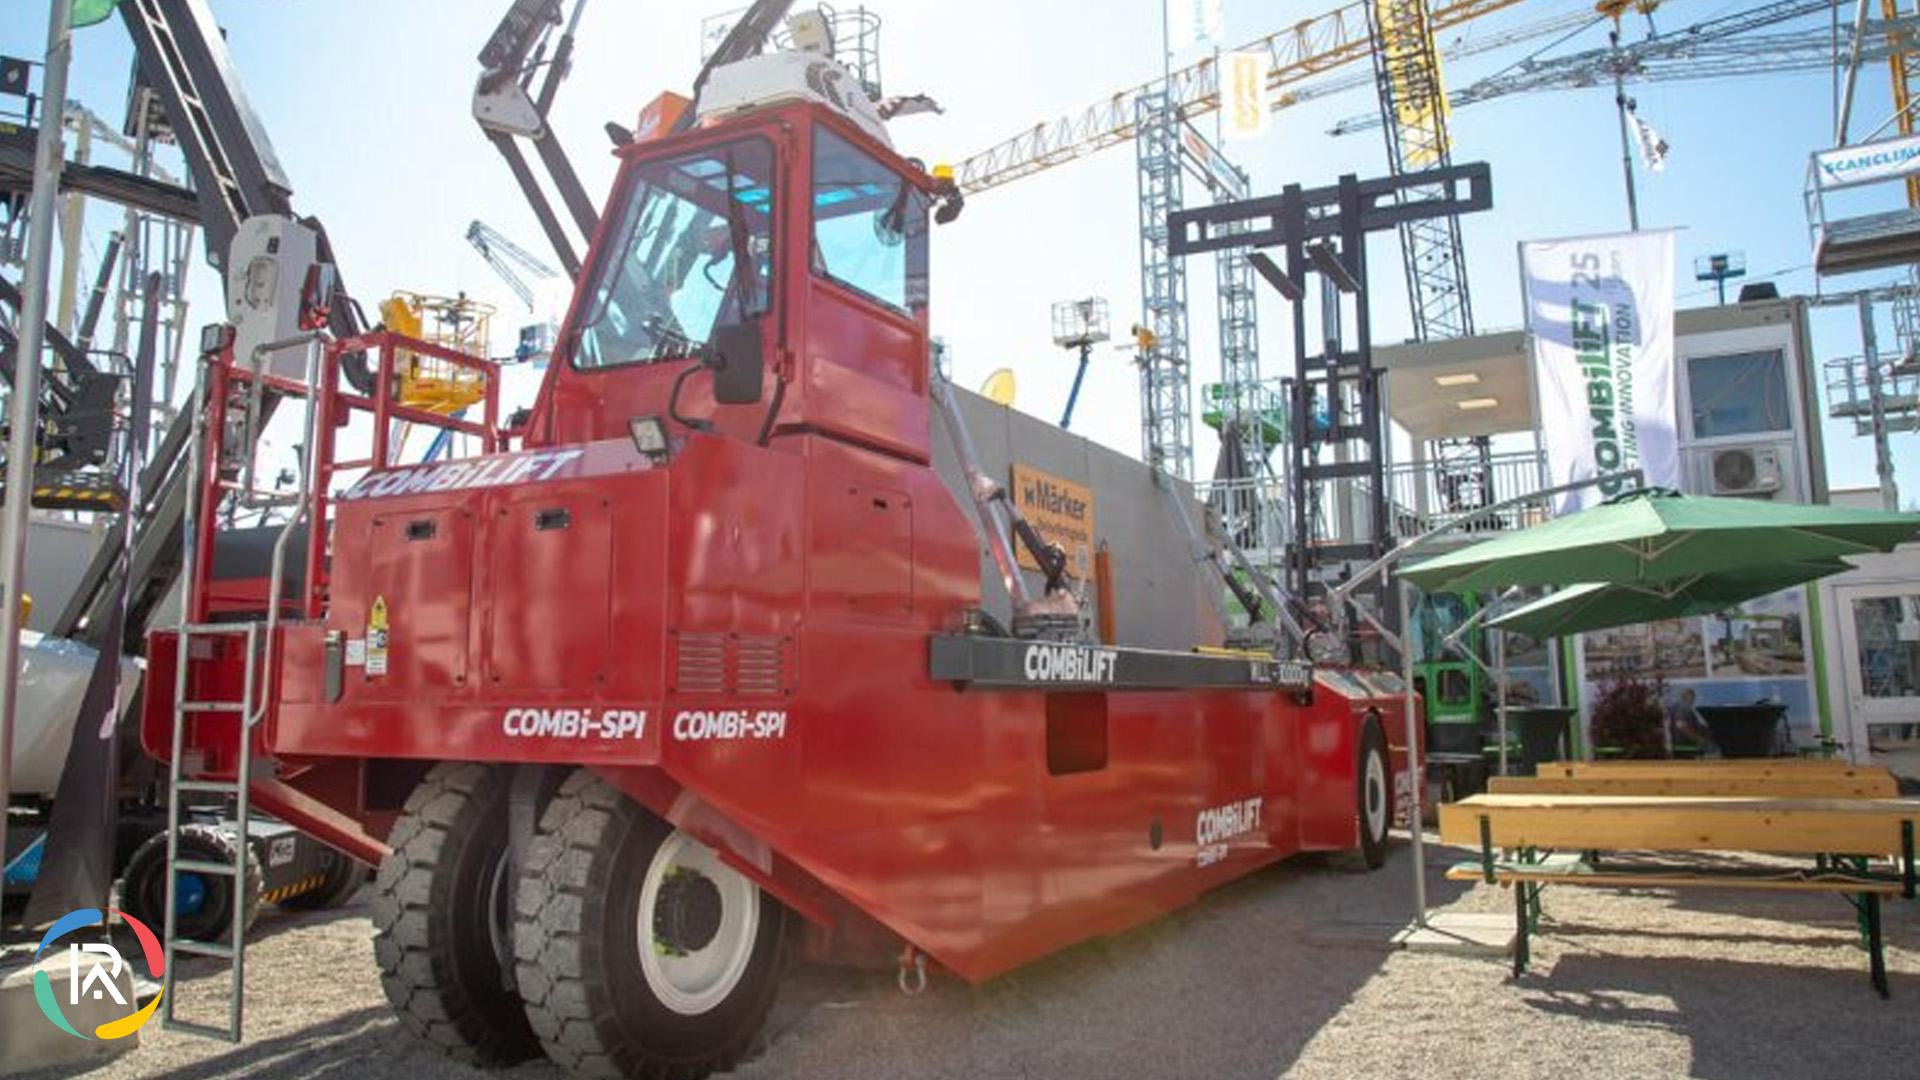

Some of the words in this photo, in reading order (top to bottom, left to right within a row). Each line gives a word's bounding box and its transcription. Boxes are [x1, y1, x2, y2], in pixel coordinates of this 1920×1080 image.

[1570, 252, 1600, 292] 25
[1615, 303, 1635, 416] INNOVATION
[1037, 479, 1087, 521] Märker
[503, 707, 646, 740] COMBi-SPI
[673, 710, 787, 741] COMBi-SPI
